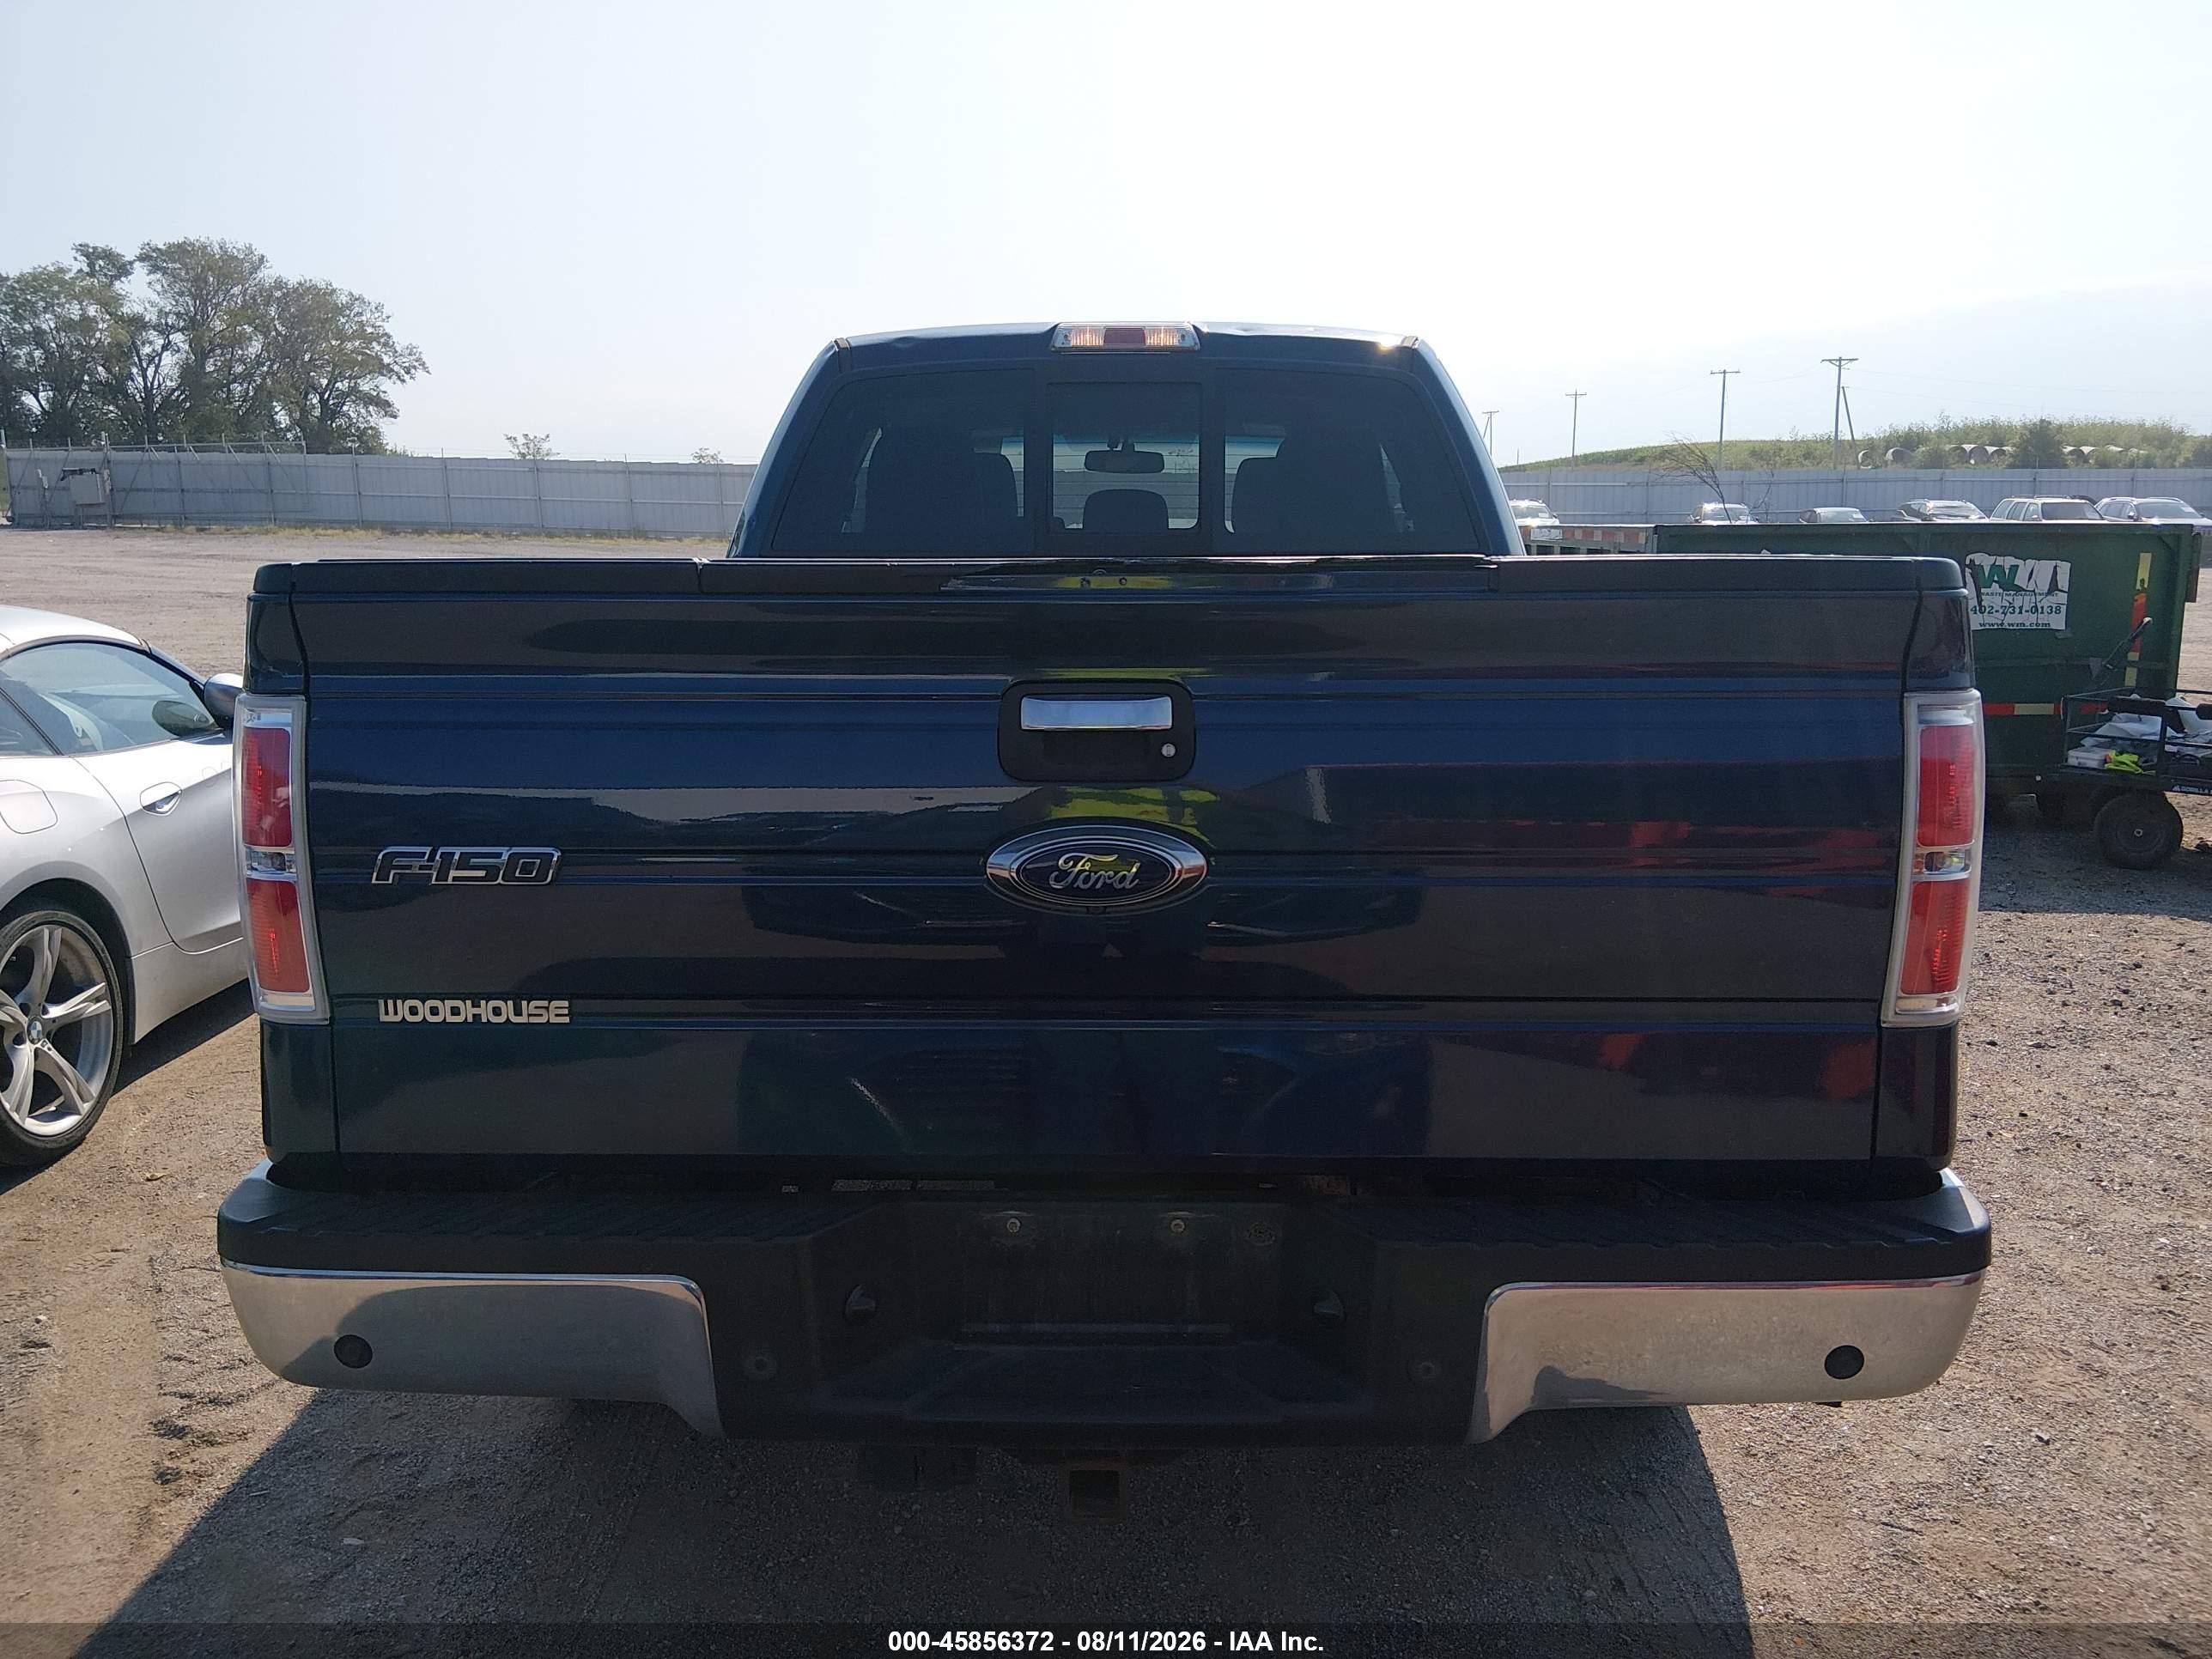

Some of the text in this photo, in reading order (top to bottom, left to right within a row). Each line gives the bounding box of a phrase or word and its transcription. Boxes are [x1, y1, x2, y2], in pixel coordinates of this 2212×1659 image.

[1970, 605, 2062, 615] 402-731-0138
[371, 846, 562, 885] F-150
[1048, 853, 1141, 890] Ford
[378, 999, 570, 1024] WOODHOUSE
